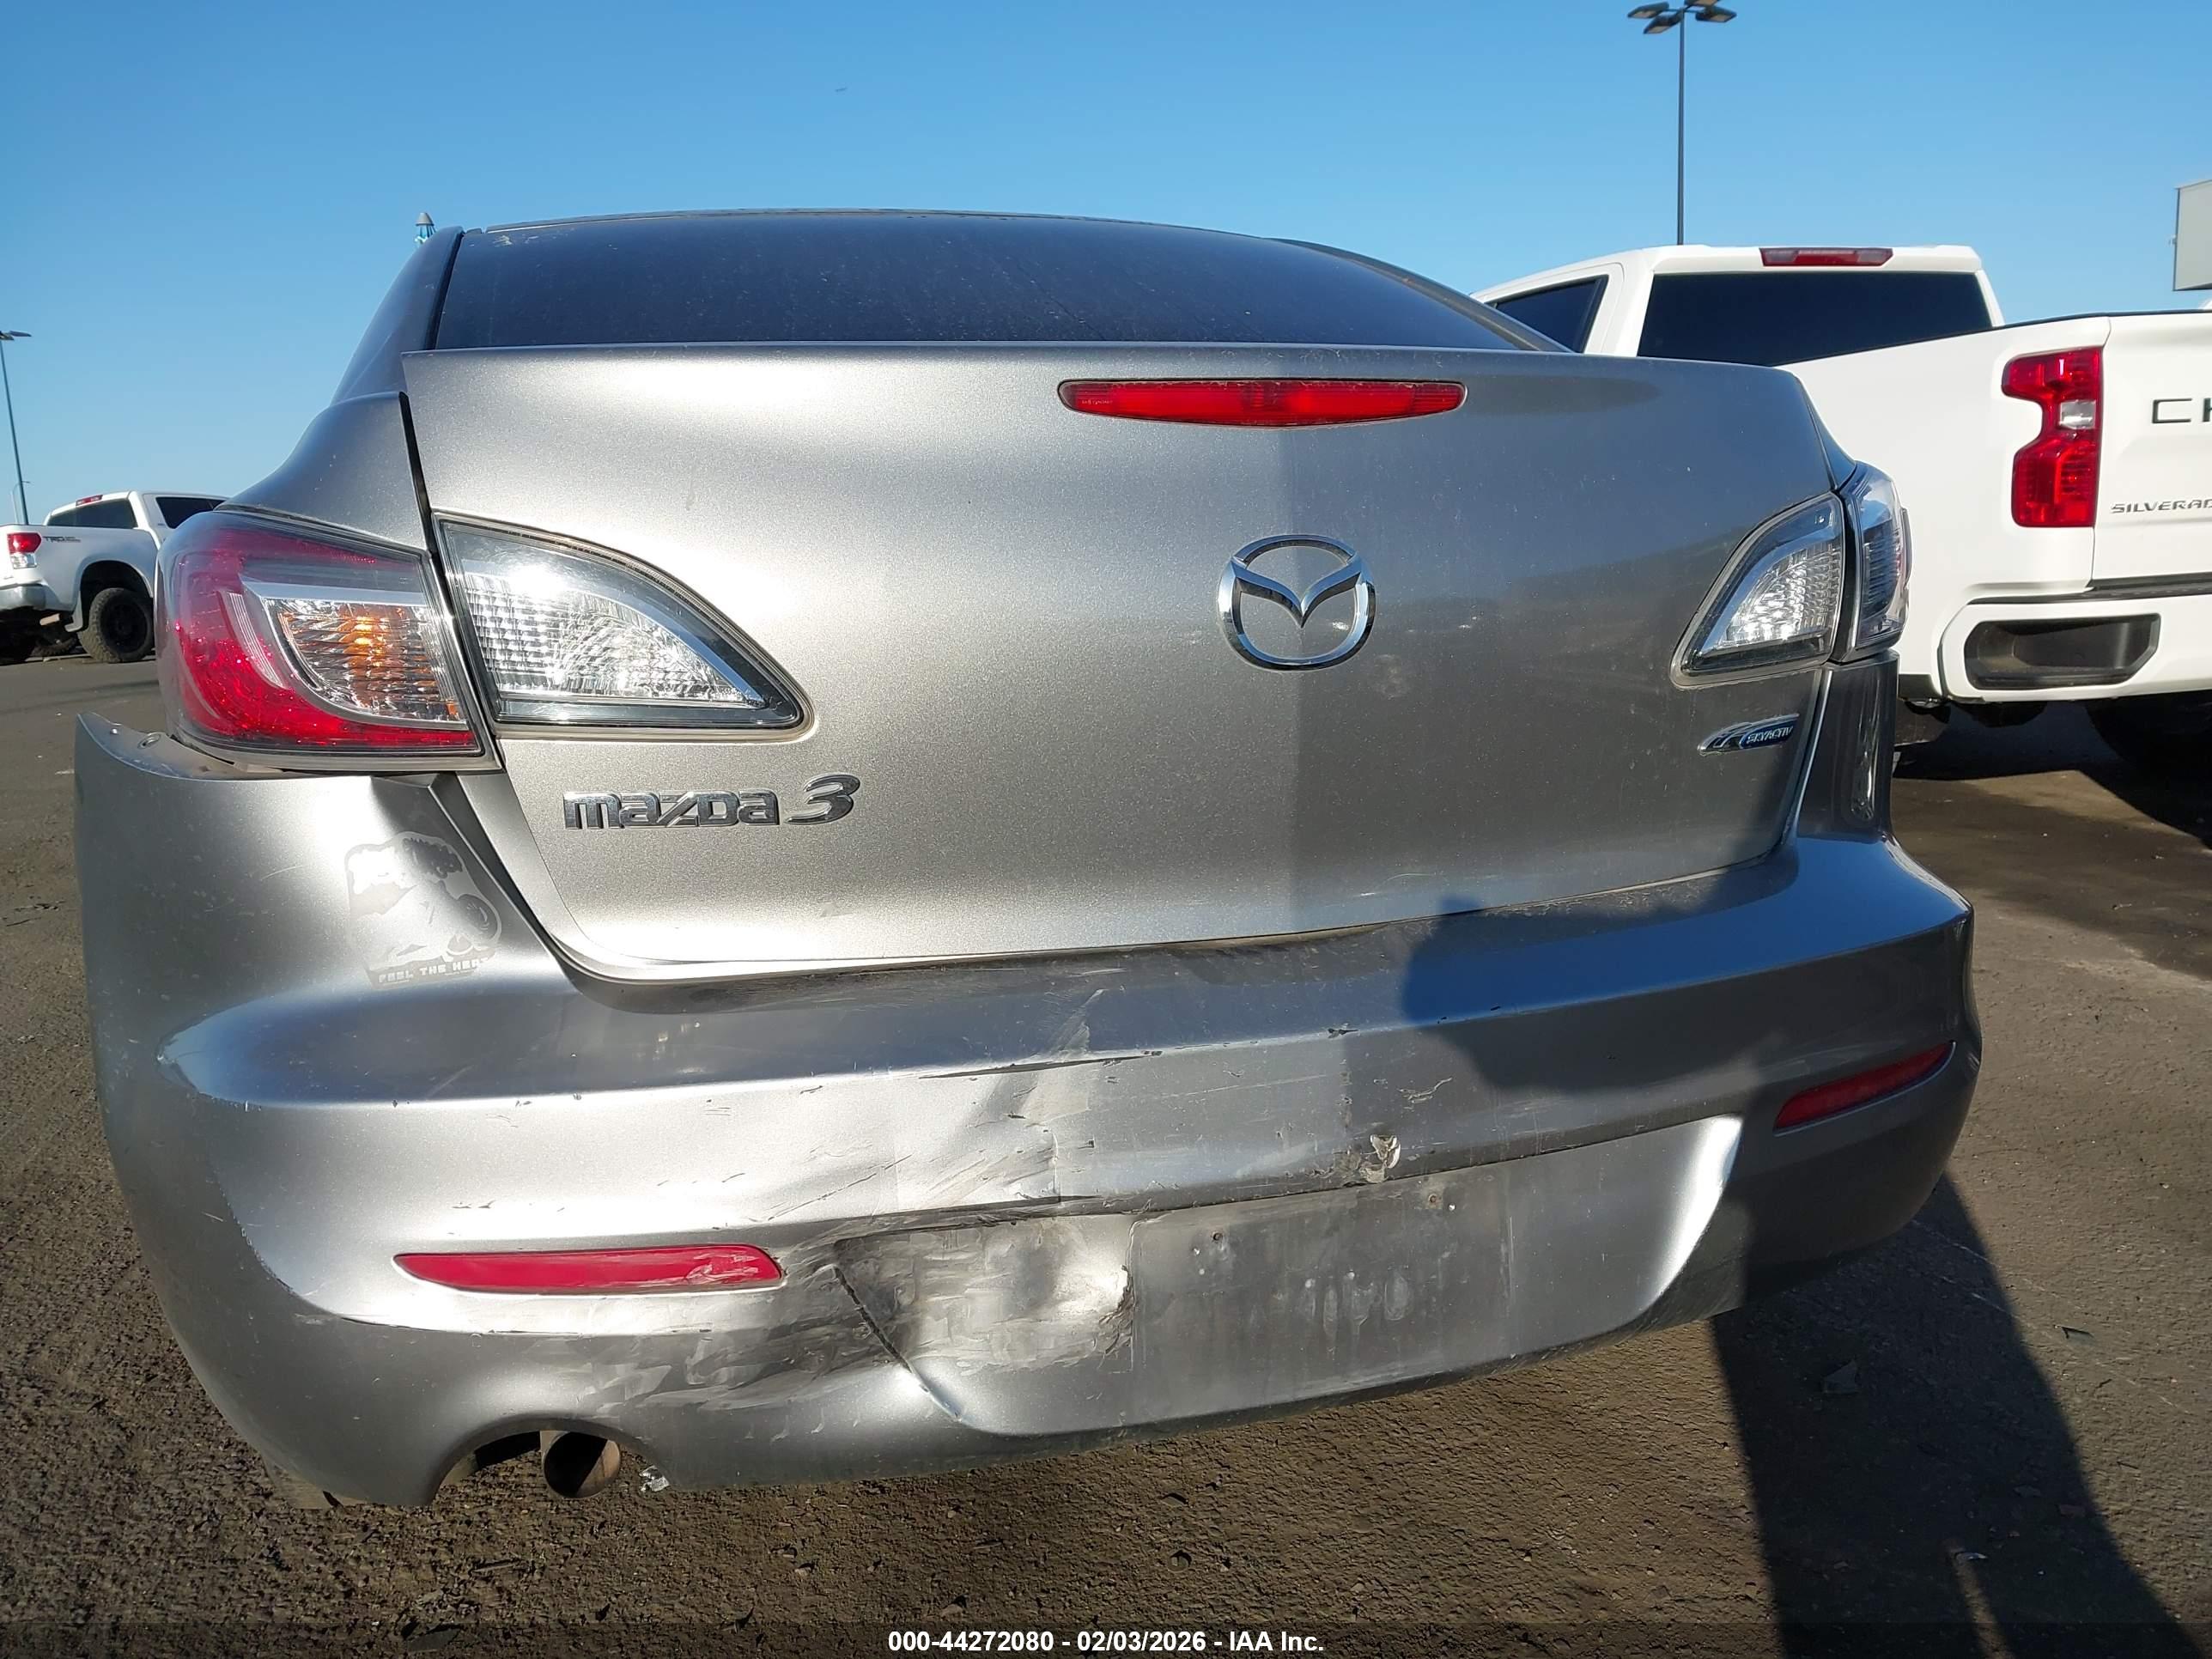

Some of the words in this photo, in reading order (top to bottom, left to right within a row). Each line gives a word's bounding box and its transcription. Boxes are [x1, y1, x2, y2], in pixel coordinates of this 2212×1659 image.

[1747, 726, 1794, 744] SKYACTIV
[787, 774, 860, 825] 3
[378, 969, 414, 983] FEEL
[419, 963, 447, 976] THE
